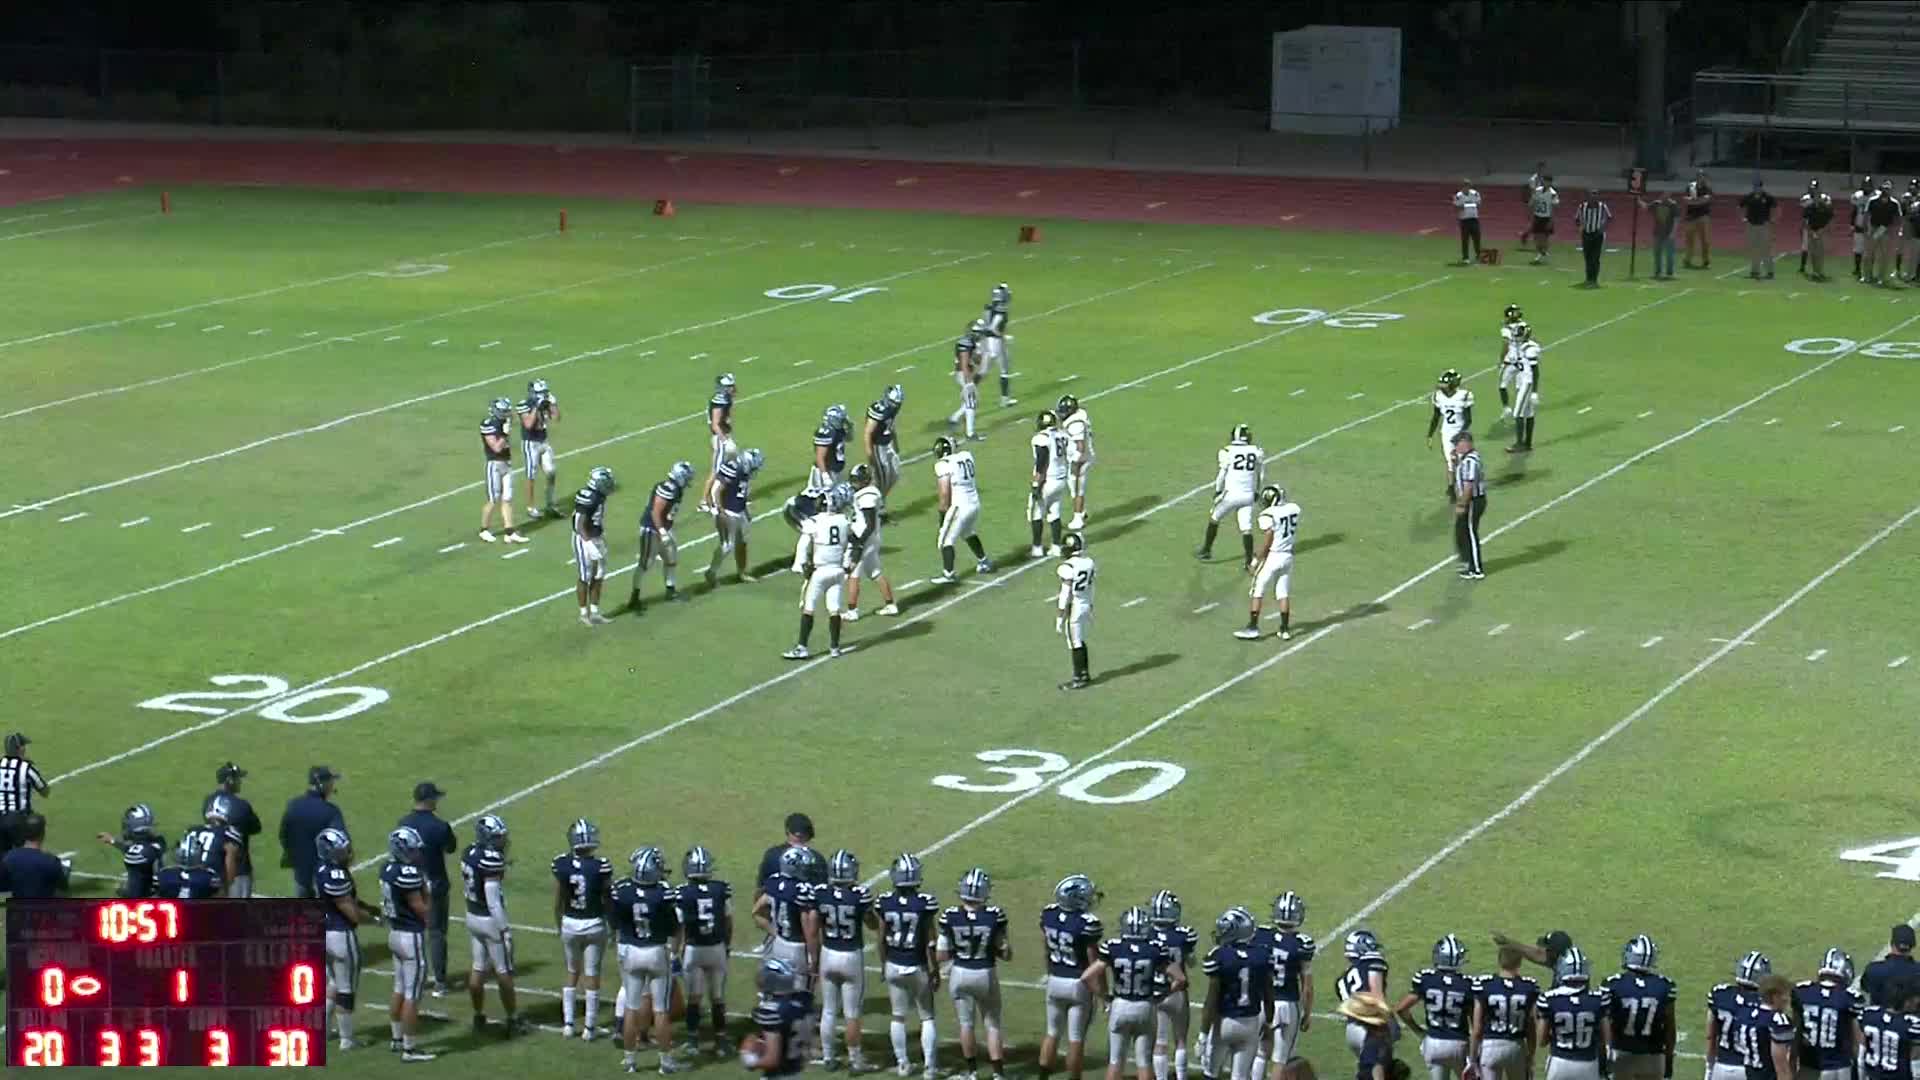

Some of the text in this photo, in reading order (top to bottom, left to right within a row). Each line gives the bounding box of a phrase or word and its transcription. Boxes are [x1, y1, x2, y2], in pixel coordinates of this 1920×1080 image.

[762, 284, 888, 303] 10
[1251, 308, 1406, 328] 20
[1445, 409, 1456, 424] 2
[956, 459, 975, 480] 70
[1233, 453, 1257, 471] 28
[830, 526, 840, 545] 8
[1280, 514, 1298, 538] 75
[135, 674, 390, 723] 20
[0, 769, 16, 791] H
[931, 750, 1187, 804] 30
[569, 874, 587, 910] 3
[697, 898, 715, 934] 5
[820, 904, 856, 939] 35
[884, 912, 919, 949] 37
[951, 926, 992, 959] 57
[1113, 958, 1151, 996] 32
[1237, 967, 1249, 1006] 1
[1425, 988, 1465, 1028] 25
[1488, 994, 1526, 1034] 36
[1622, 997, 1659, 1036] 77
[1802, 1004, 1839, 1048] 50
[1554, 1011, 1595, 1049] 26
[1734, 1024, 1763, 1068] 41
